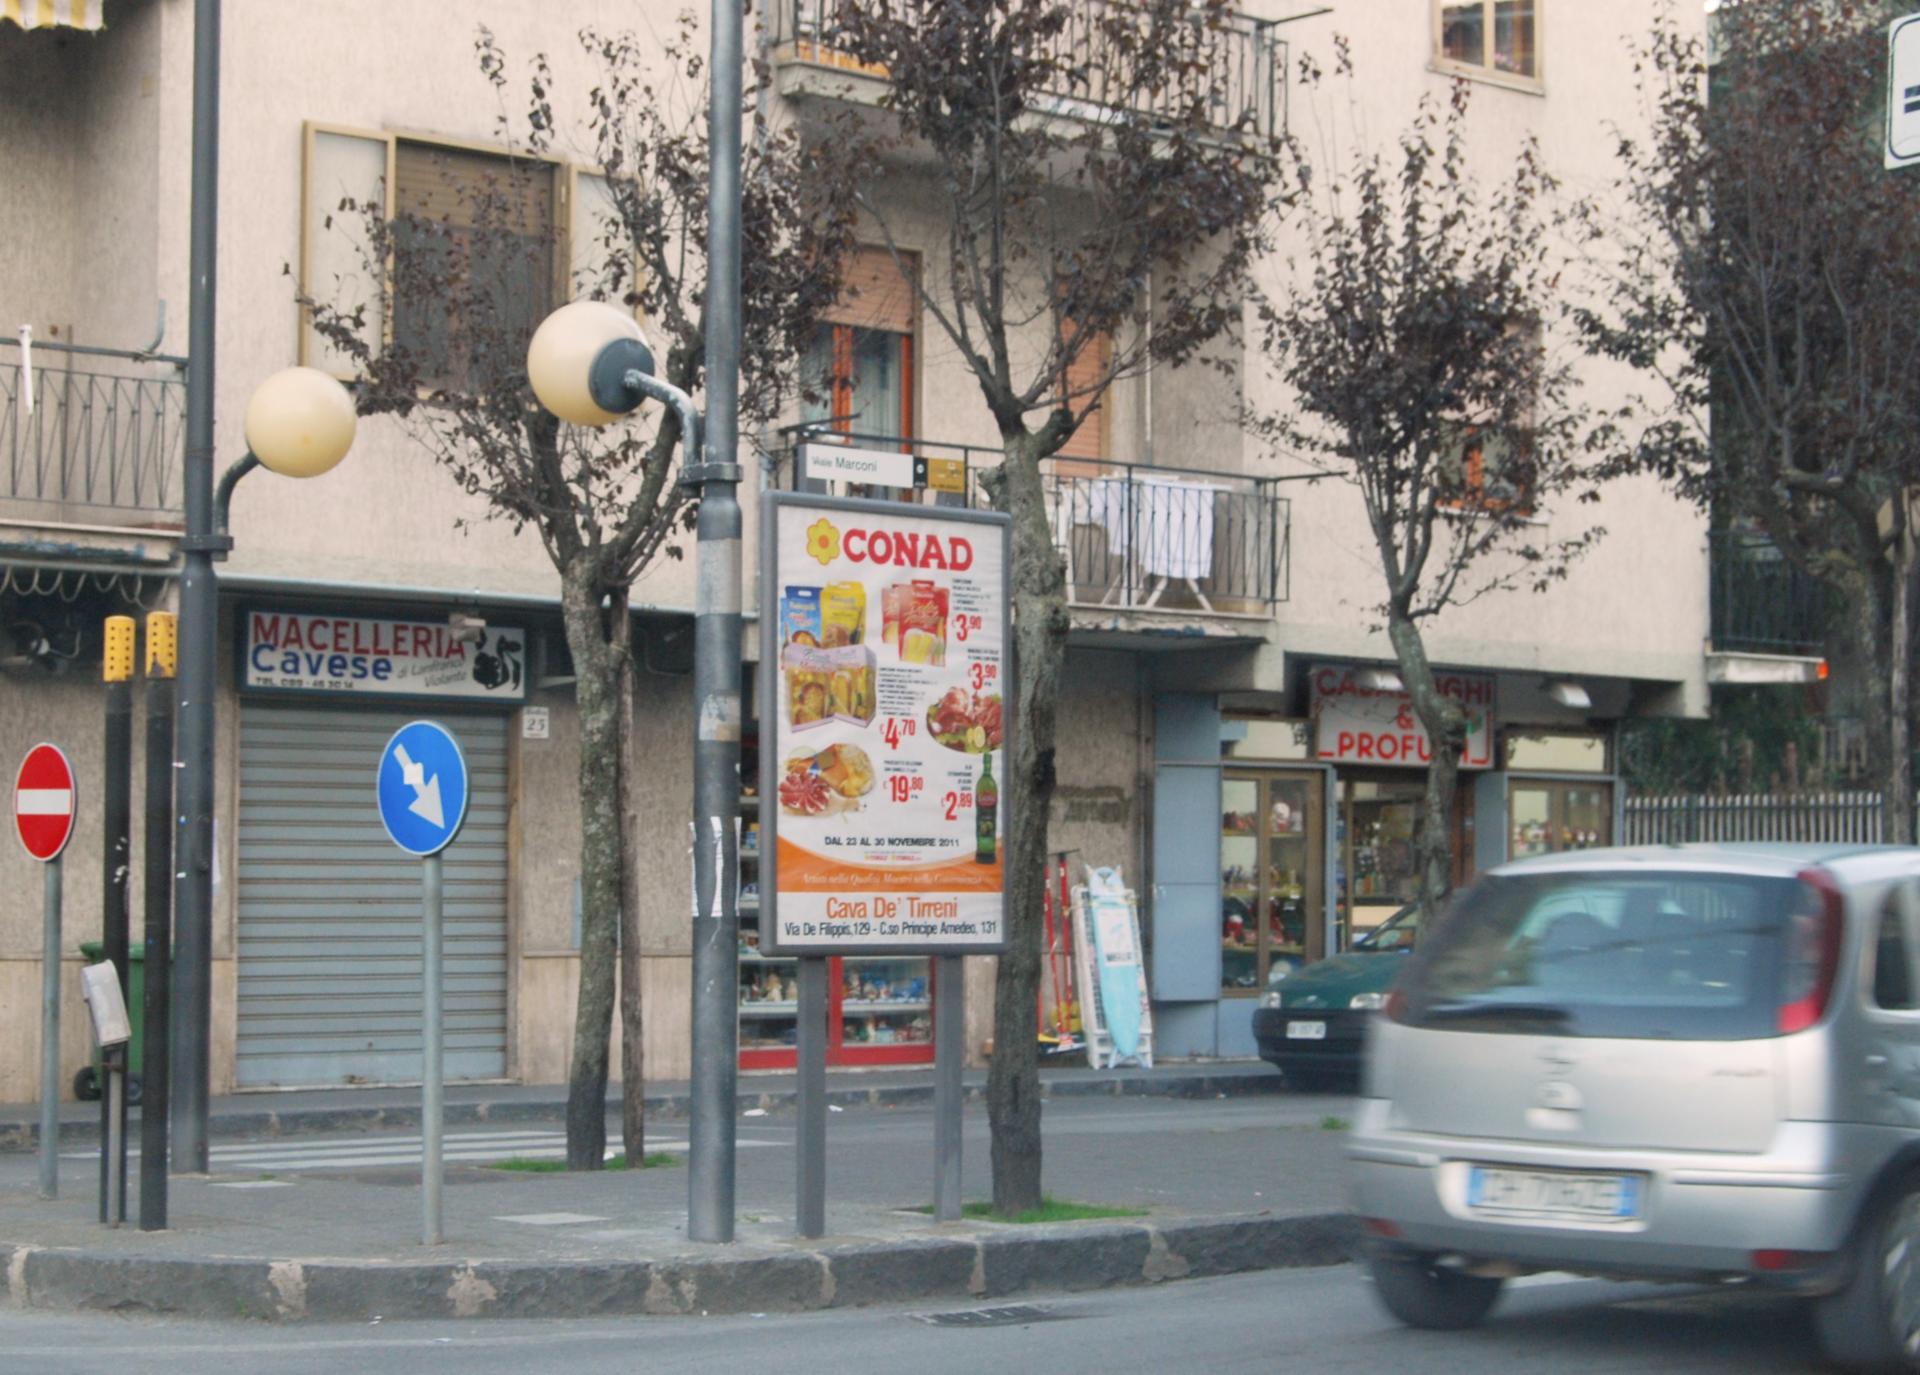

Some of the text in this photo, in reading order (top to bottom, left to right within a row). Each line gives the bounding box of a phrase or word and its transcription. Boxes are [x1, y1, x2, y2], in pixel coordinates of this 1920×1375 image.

[835, 457, 878, 472] Marconi
[843, 528, 973, 572] CONAD
[252, 613, 466, 660] MACELLERIA
[251, 643, 393, 681] Cavese
[526, 718, 545, 730] 25
[825, 836, 960, 847] DAL 23 AL 30 NOVEMBRE 2011
[826, 897, 958, 919] Cava De' Tirreni
[785, 922, 800, 935] Via
[803, 922, 816, 935] De
[879, 922, 900, 935] C.so
[901, 922, 938, 937] Principe
[981, 922, 996, 934] 131
